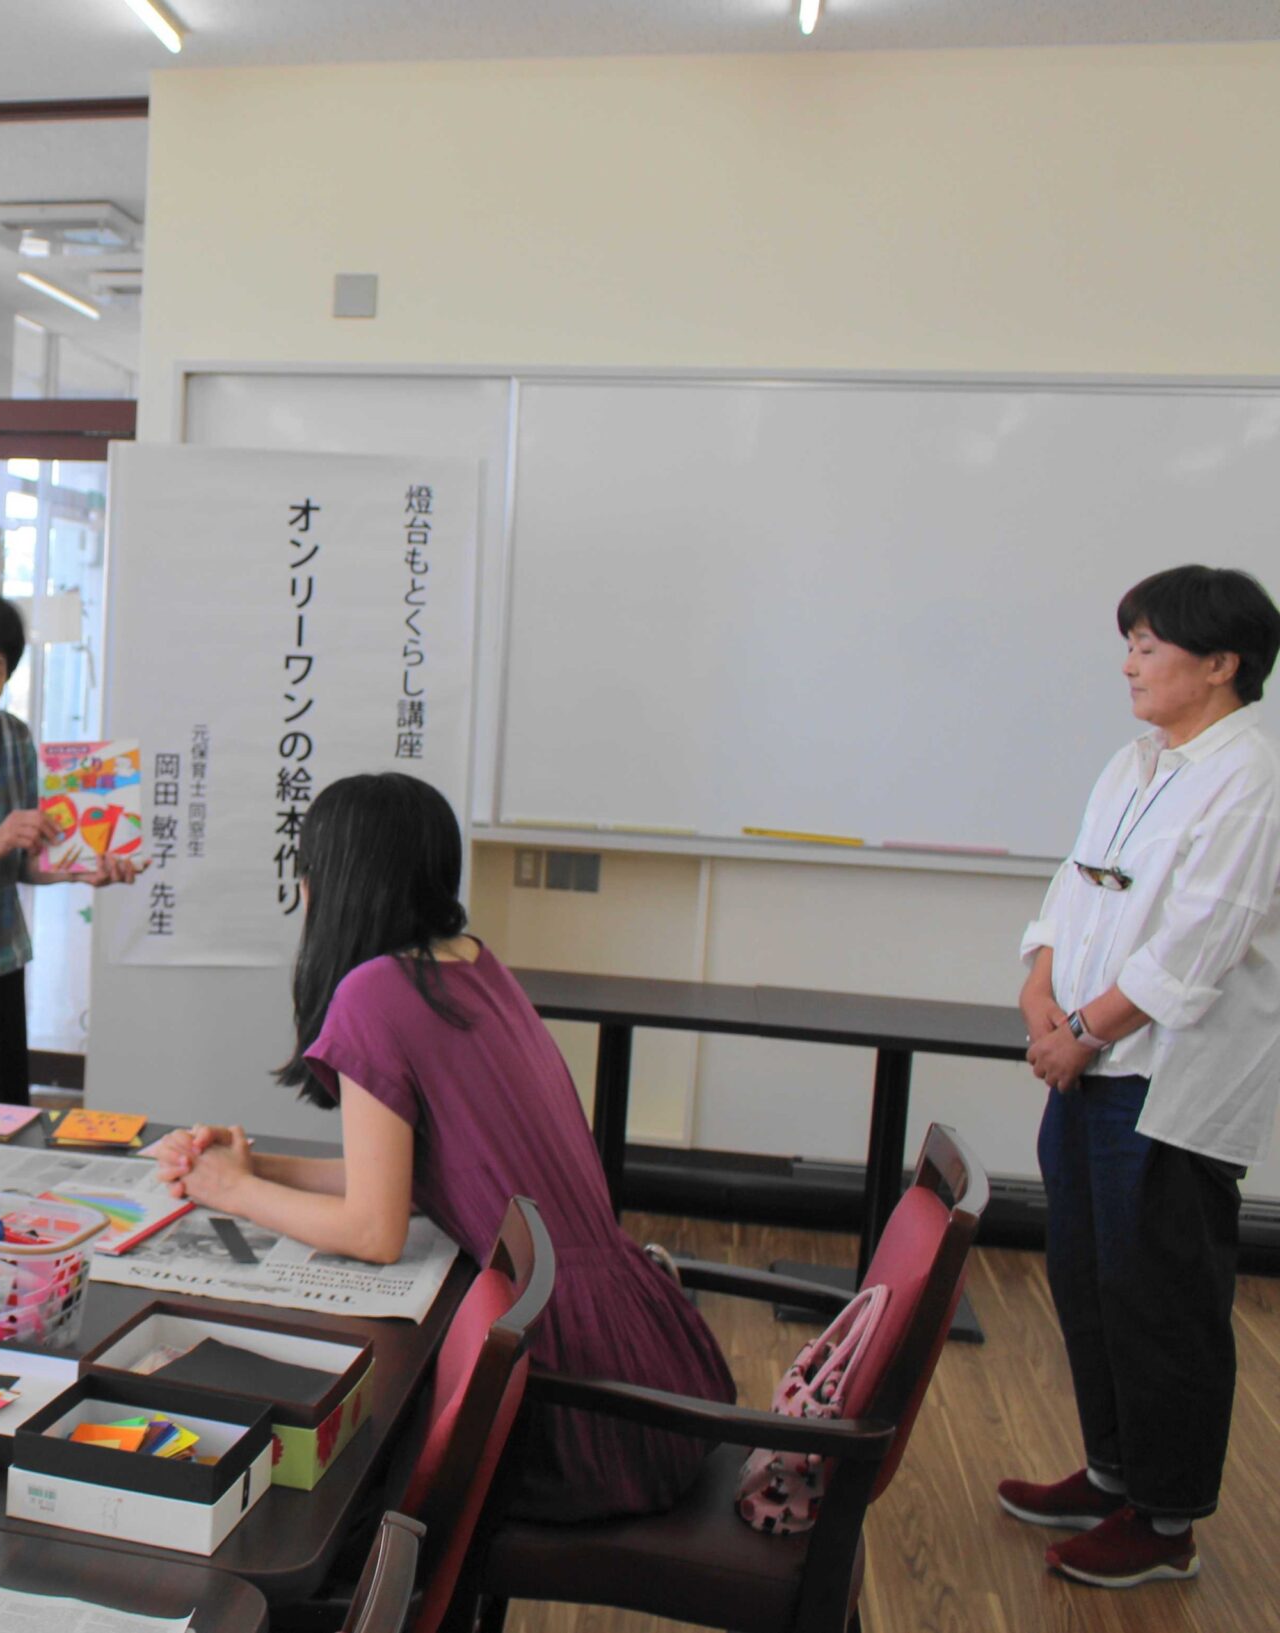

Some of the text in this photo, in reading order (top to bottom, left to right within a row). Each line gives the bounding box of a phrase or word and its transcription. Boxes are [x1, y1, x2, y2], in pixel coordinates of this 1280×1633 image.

[273, 498, 321, 916] オンリーワンの絵本作り
[395, 484, 433, 760] 燈台もとくらし講座
[148, 753, 180, 935] 岡田 敏子 先生
